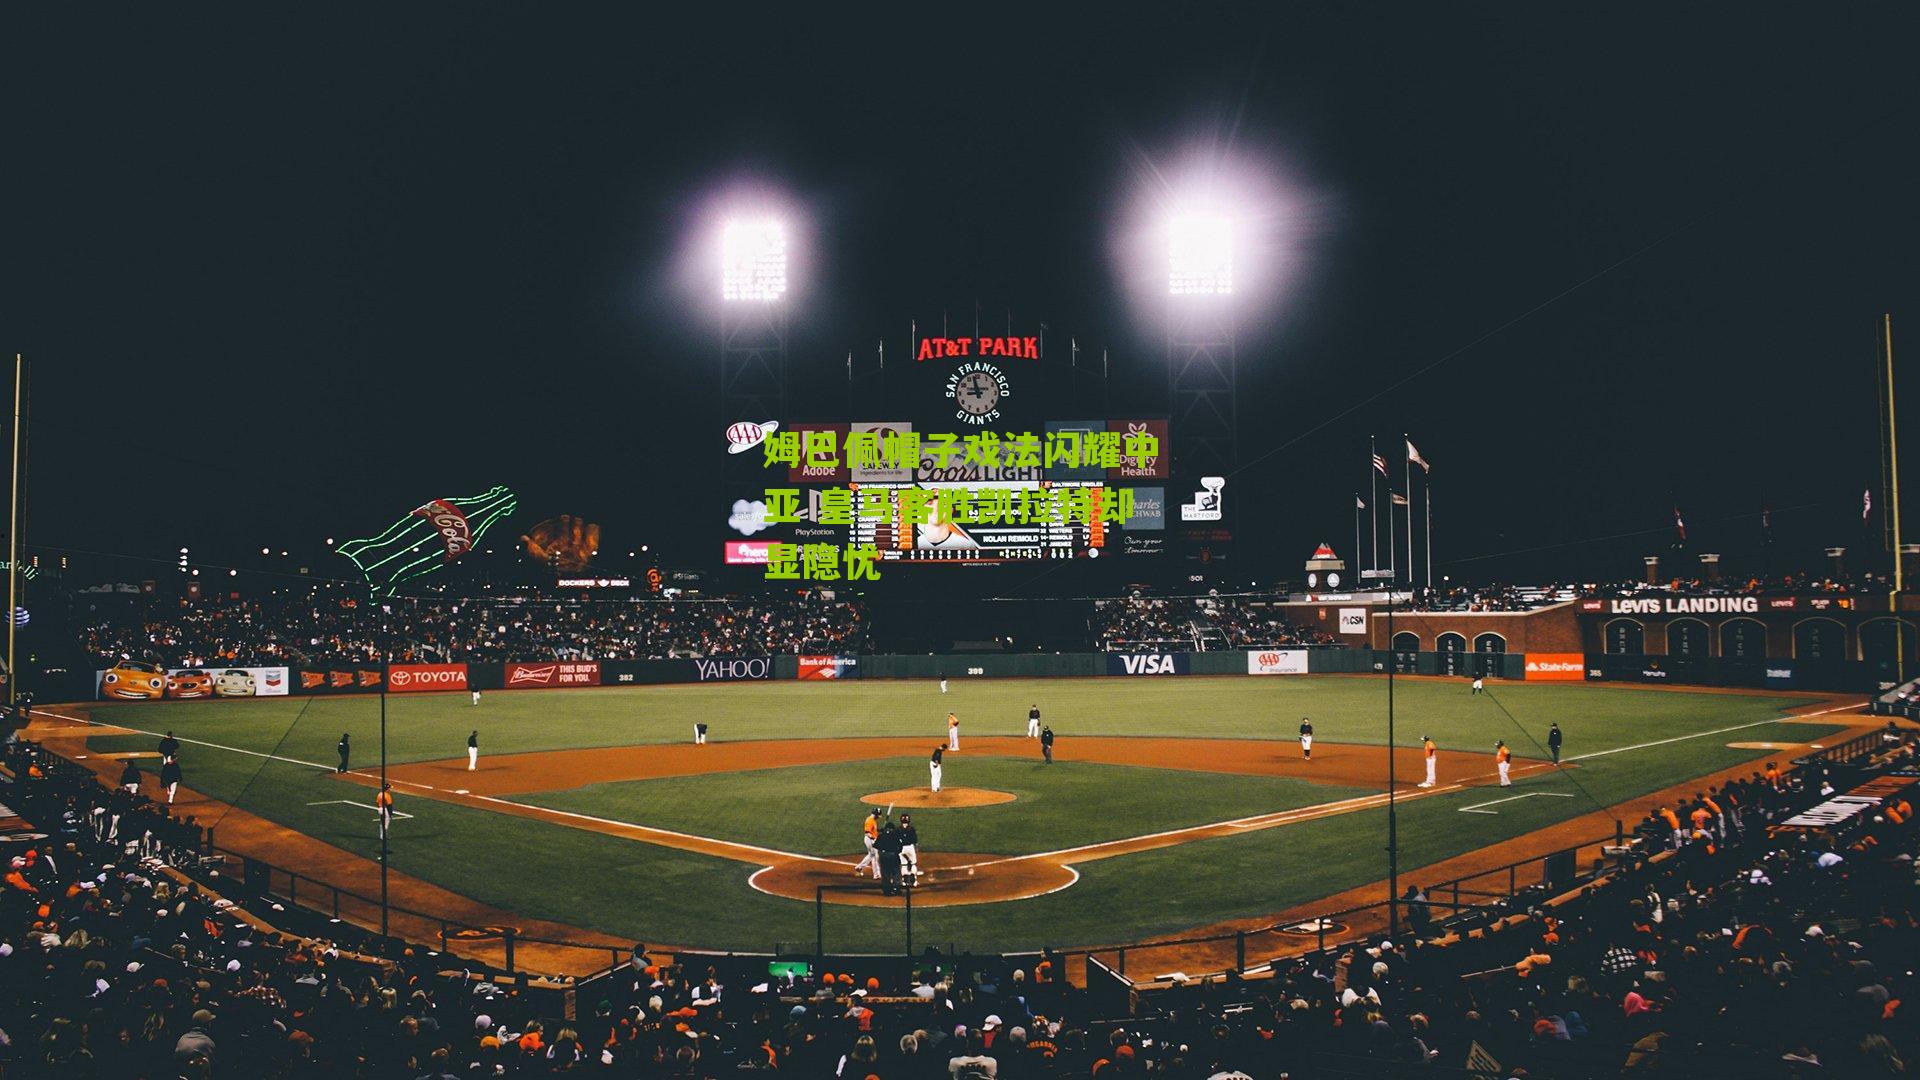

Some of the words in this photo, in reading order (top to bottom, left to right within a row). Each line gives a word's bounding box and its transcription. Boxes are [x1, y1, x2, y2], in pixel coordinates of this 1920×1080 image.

[917, 338, 972, 361] AT&T
[979, 337, 1038, 360] PARK
[945, 373, 960, 398] SAN
[957, 361, 1010, 397] FRANCISCO
[956, 409, 1001, 425] GIANTS
[1119, 454, 1157, 467] Digity
[917, 458, 982, 482] Coors
[1121, 466, 1156, 476] Health
[795, 528, 835, 537] PlayStation
[558, 579, 595, 587] DOCKERS
[1665, 597, 1759, 613] LANDING
[1350, 616, 1364, 625] CSN
[800, 658, 819, 666] Bank
[826, 658, 856, 666] America
[1118, 654, 1176, 674] VISA
[1538, 662, 1562, 672] State
[1563, 661, 1584, 672] Farm
[559, 665, 575, 673] THIS
[576, 664, 598, 673] BUD'S
[695, 658, 770, 681] YAHOO!
[967, 667, 984, 675] 399
[413, 671, 467, 683] TOYOTA
[559, 674, 574, 683] FOR
[575, 674, 590, 682] YOU.
